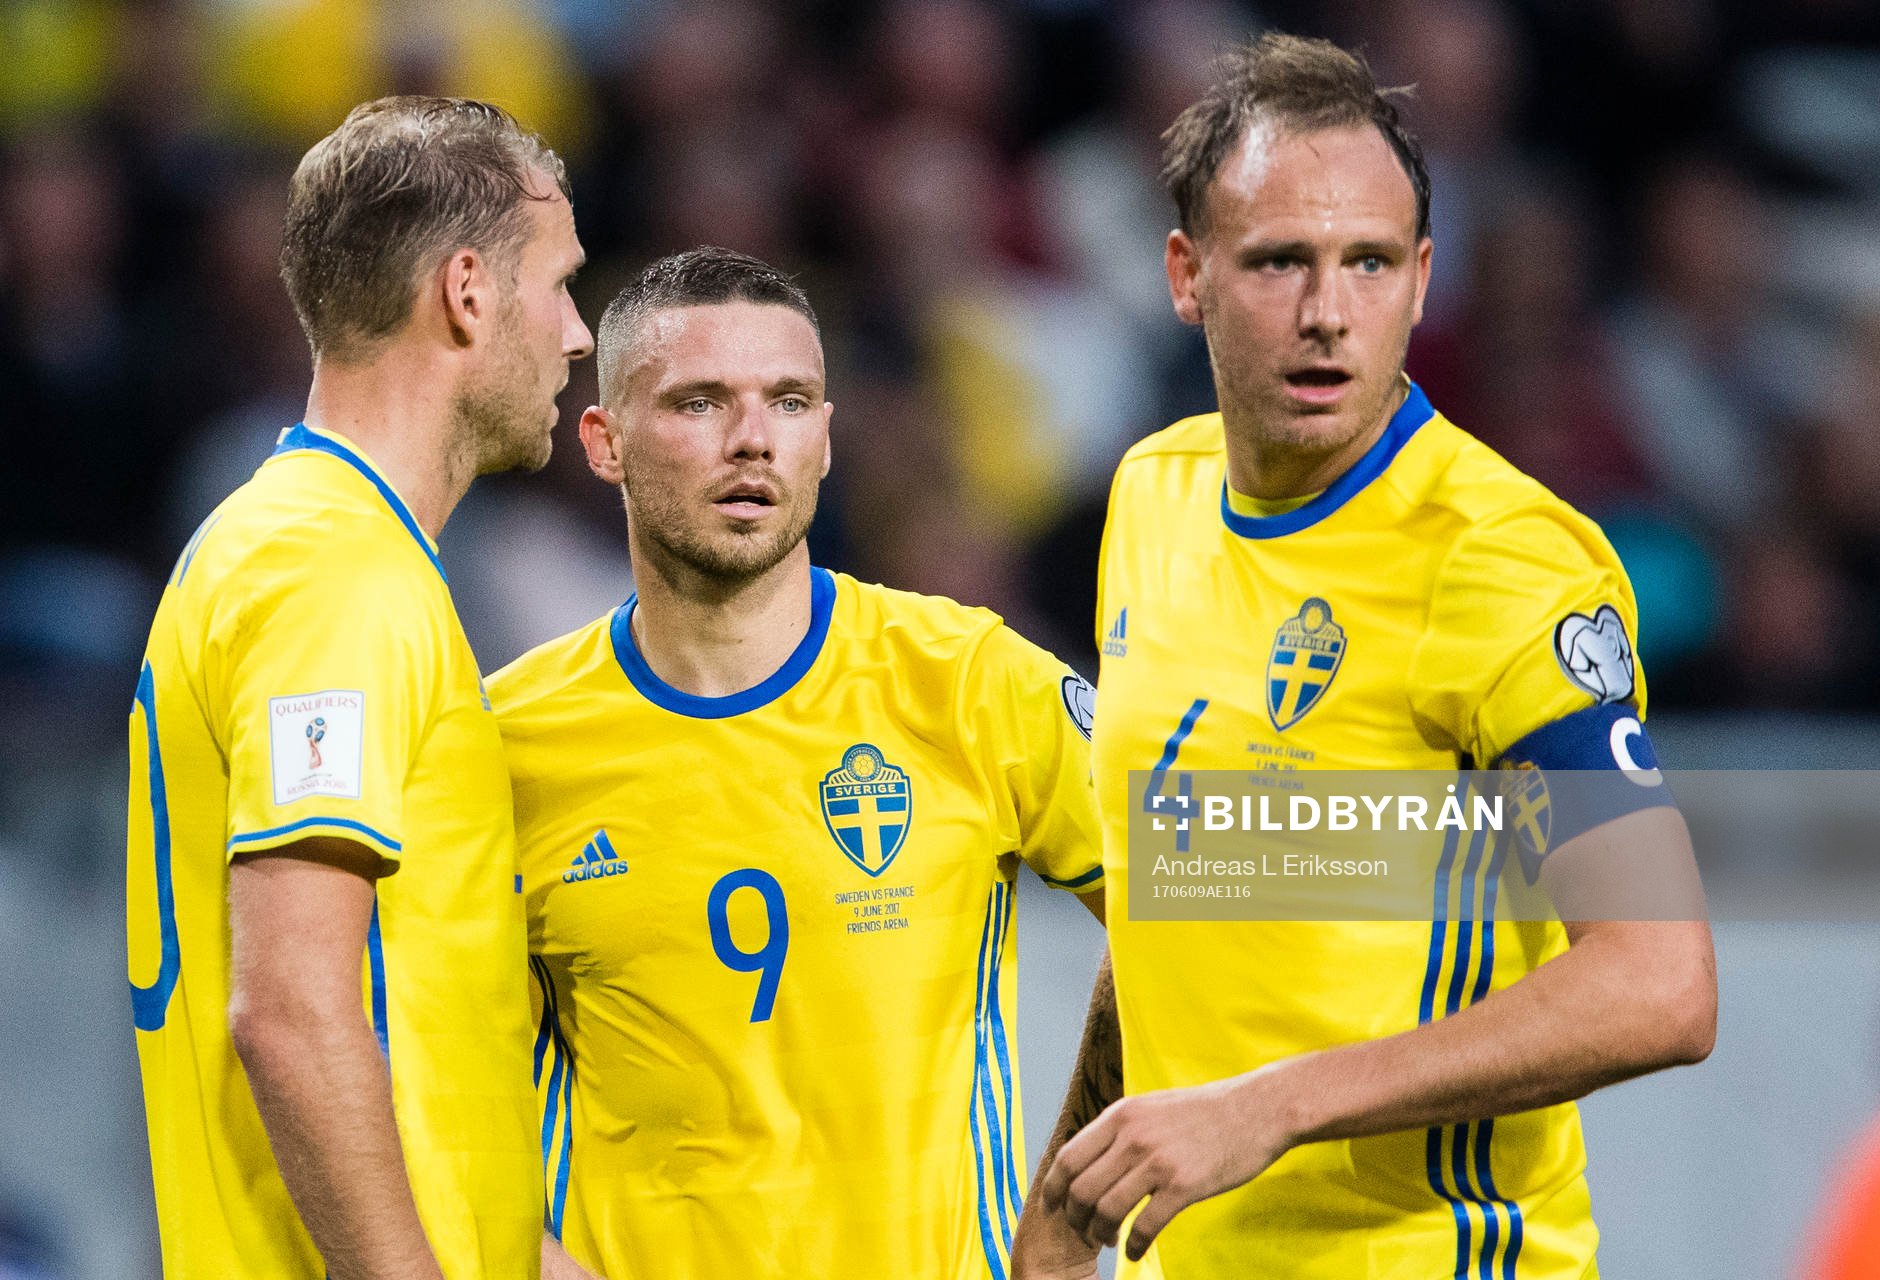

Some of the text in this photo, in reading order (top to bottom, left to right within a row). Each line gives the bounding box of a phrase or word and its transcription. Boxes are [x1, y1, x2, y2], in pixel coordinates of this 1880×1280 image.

[275, 695, 358, 717] QUALIFIERS
[1610, 716, 1663, 787] C
[1143, 698, 1209, 852] 4
[835, 783, 897, 797] SVERIGE
[562, 858, 628, 884] adidas
[834, 886, 915, 905] SWEDEN VS FRANCE
[853, 902, 900, 918] 9 JUNE 2017
[847, 918, 909, 934] FRIENDS ARENA
[707, 867, 789, 1024] 9
